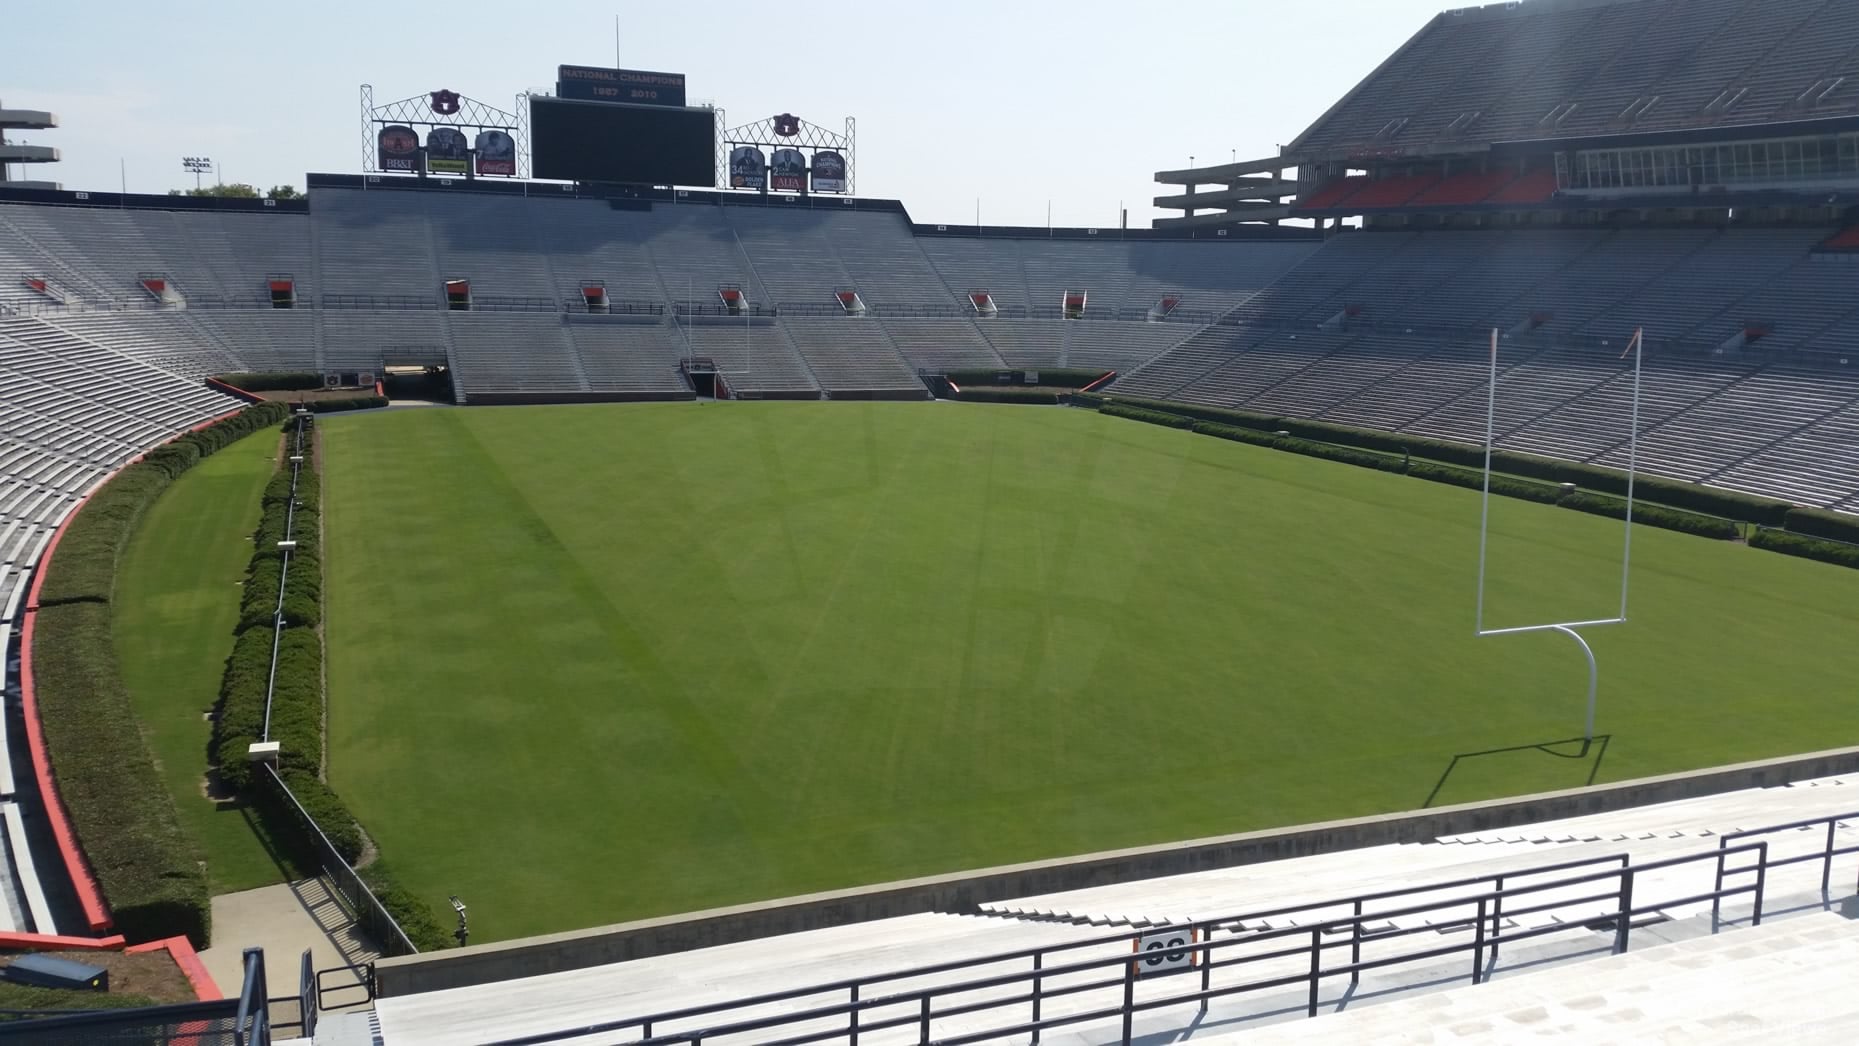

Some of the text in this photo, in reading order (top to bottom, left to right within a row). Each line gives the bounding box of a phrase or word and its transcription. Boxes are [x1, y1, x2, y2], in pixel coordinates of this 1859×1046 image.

[563, 69, 683, 86] NATIONAL CHAMPIONS
[386, 158, 413, 169] BB&T
[732, 164, 743, 175] 34
[773, 166, 779, 176] 2
